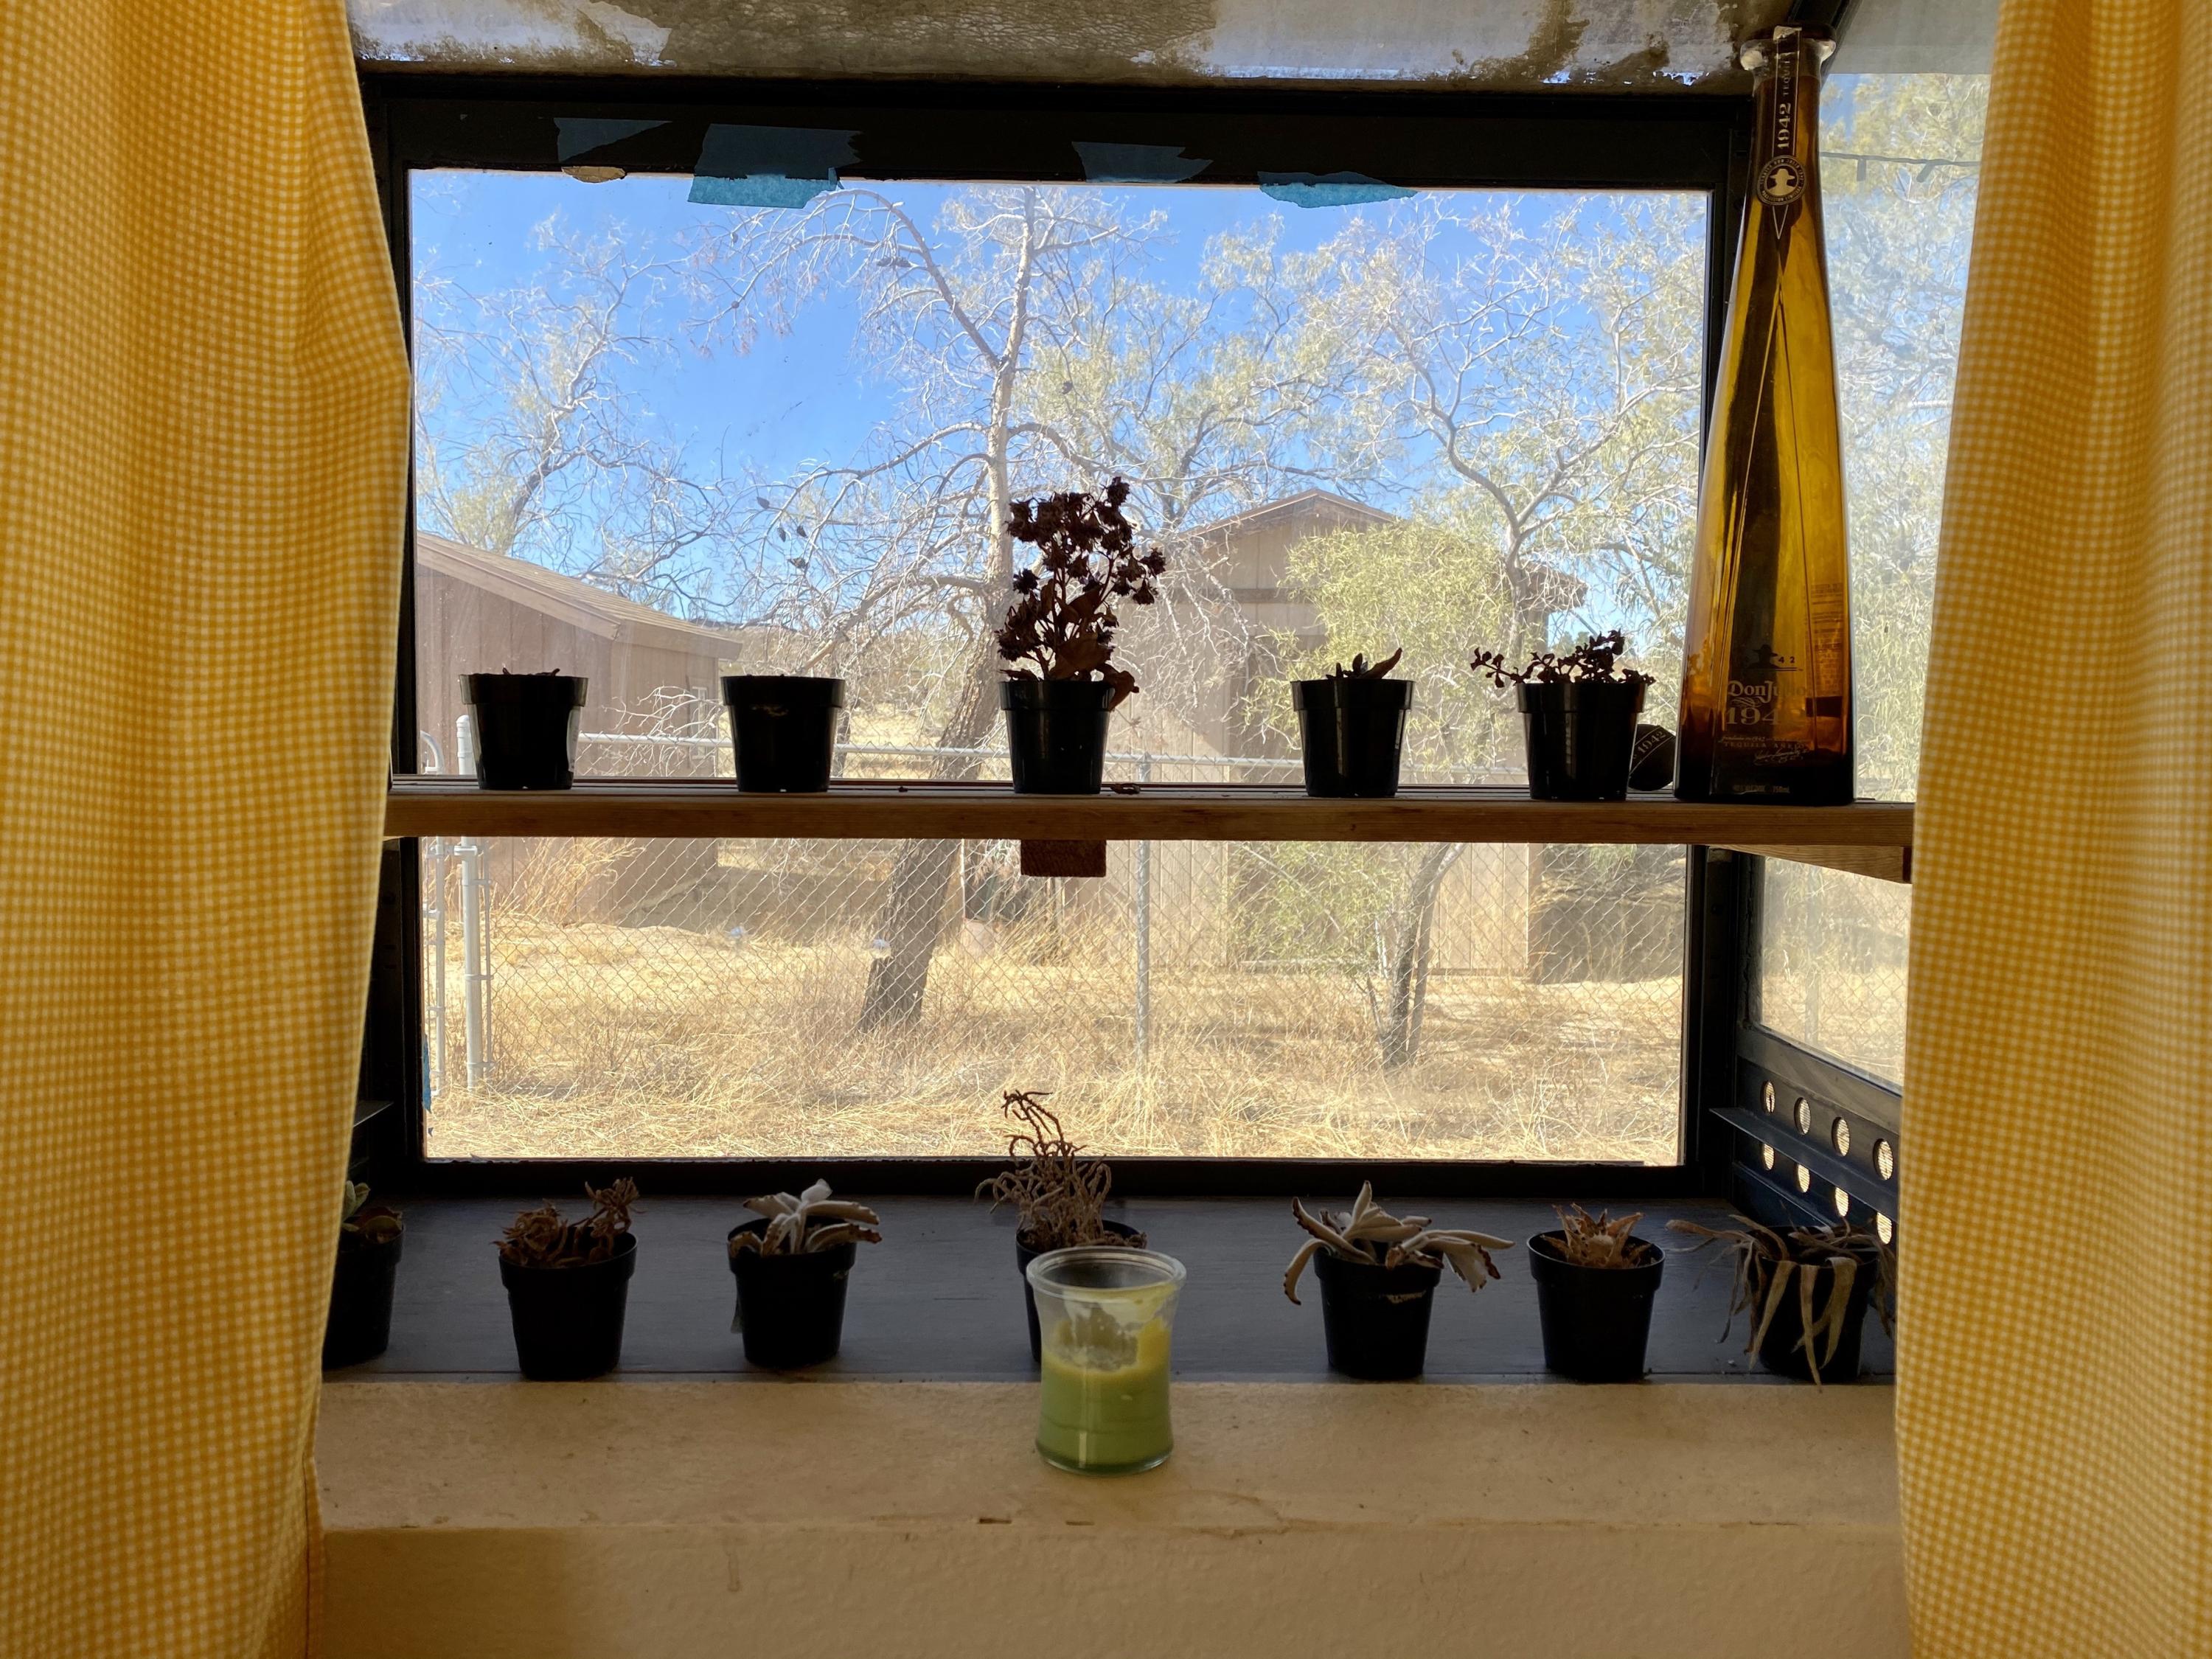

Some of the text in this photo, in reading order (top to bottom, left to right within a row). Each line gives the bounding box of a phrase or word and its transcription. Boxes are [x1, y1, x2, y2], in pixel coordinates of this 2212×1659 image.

[1777, 102, 1792, 149] 1942
[1728, 680, 1767, 697] Don
[1726, 707, 1783, 726] 194
[1637, 730, 1667, 754] 1942
